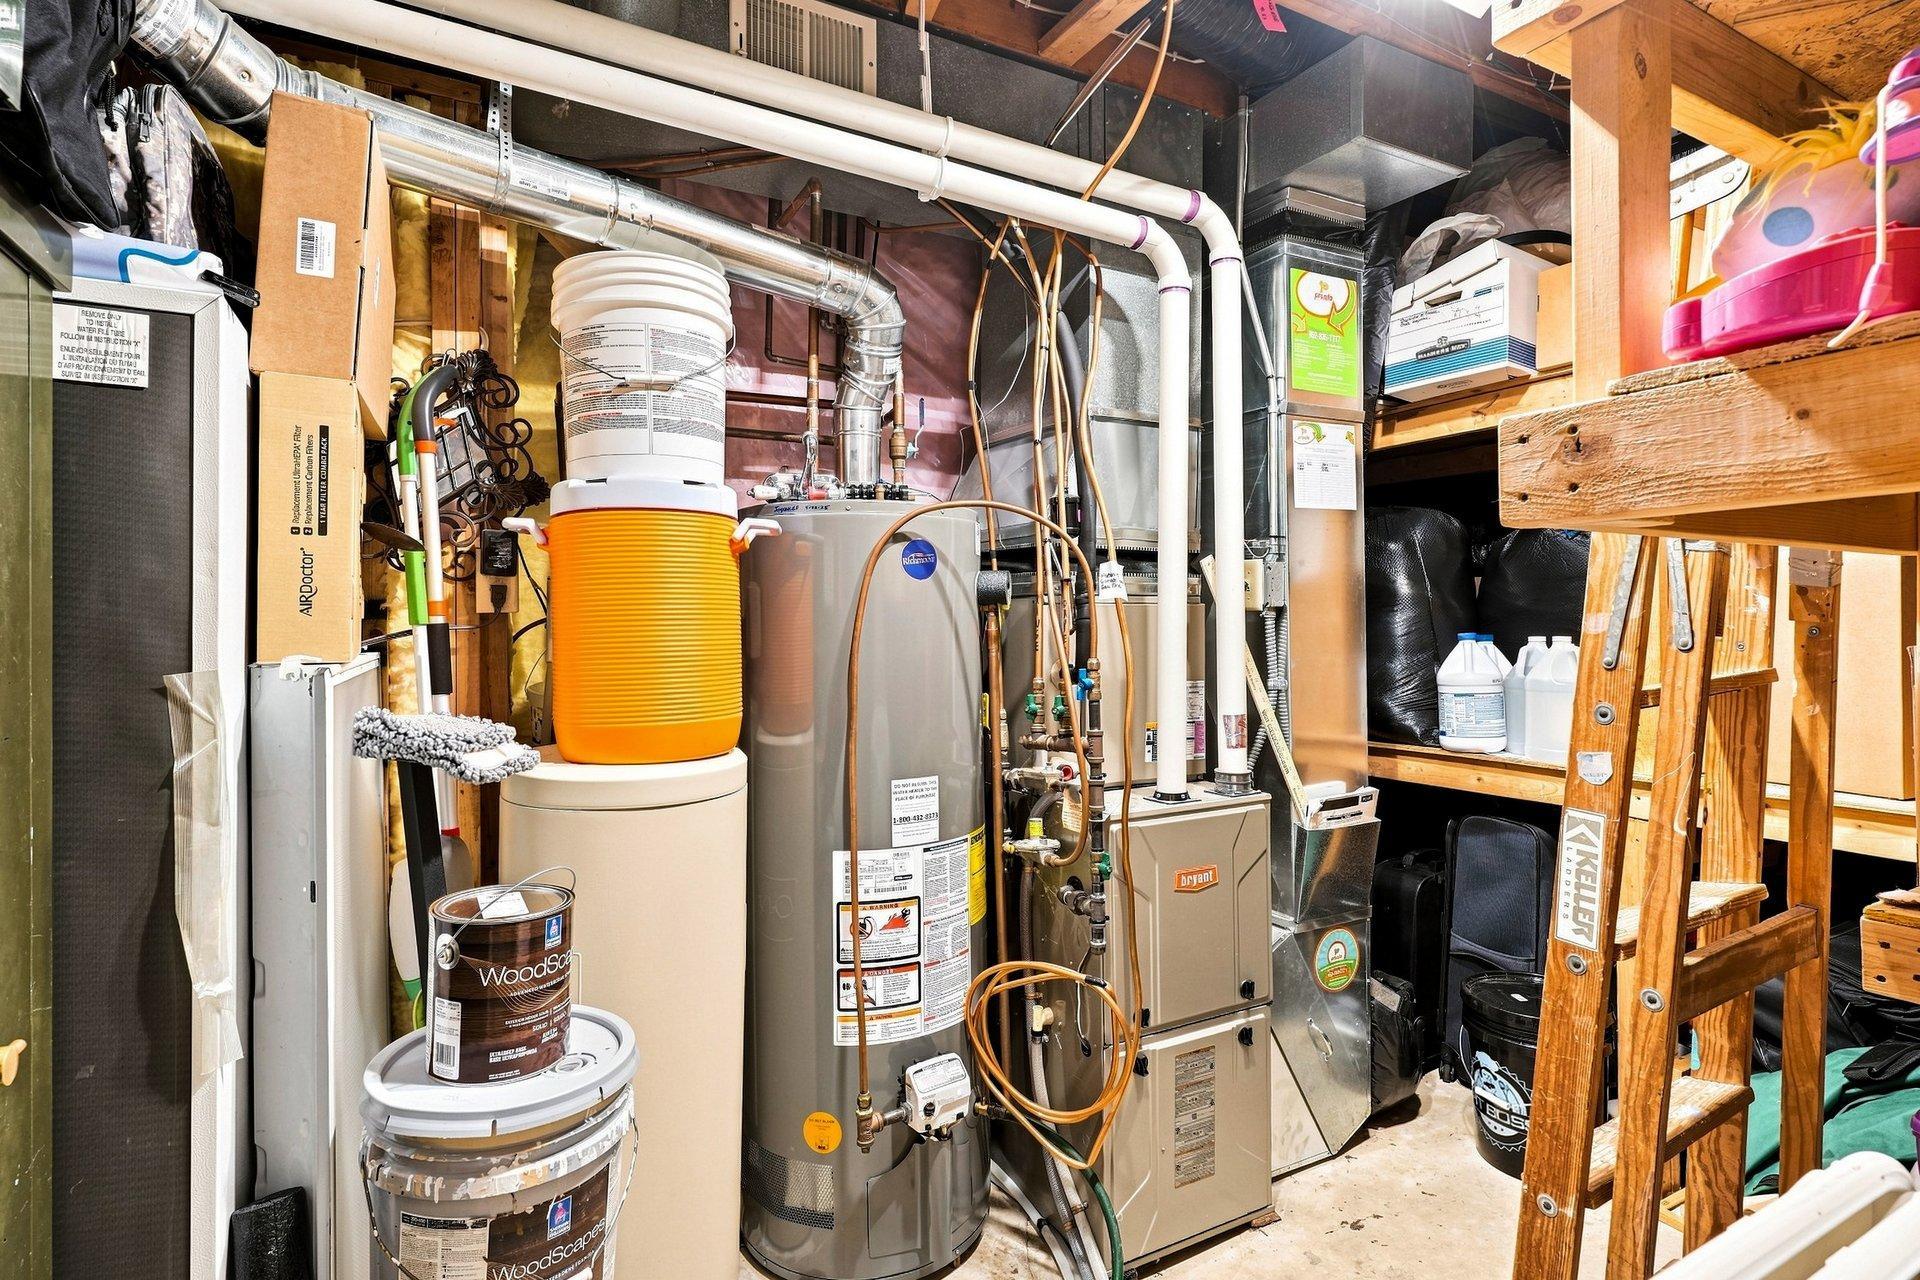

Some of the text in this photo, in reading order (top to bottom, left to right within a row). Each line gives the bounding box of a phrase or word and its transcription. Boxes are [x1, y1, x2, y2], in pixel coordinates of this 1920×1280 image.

[81, 310, 105, 319] REMOVE
[60, 332, 85, 340] FOLLOW
[77, 326, 97, 335] WATER
[293, 425, 302, 442] Filter
[305, 457, 313, 480] Carbon
[293, 481, 301, 524] Replacement
[304, 481, 313, 524] Replacement
[1181, 870, 1213, 887] bryant
[1562, 846, 1573, 920] LADDERS
[1572, 848, 1599, 944] KELLER
[869, 903, 899, 911] WARNING
[479, 949, 573, 987] WoodSca
[532, 1022, 548, 1031] SOLID
[492, 1217, 606, 1280] WoodScapes
